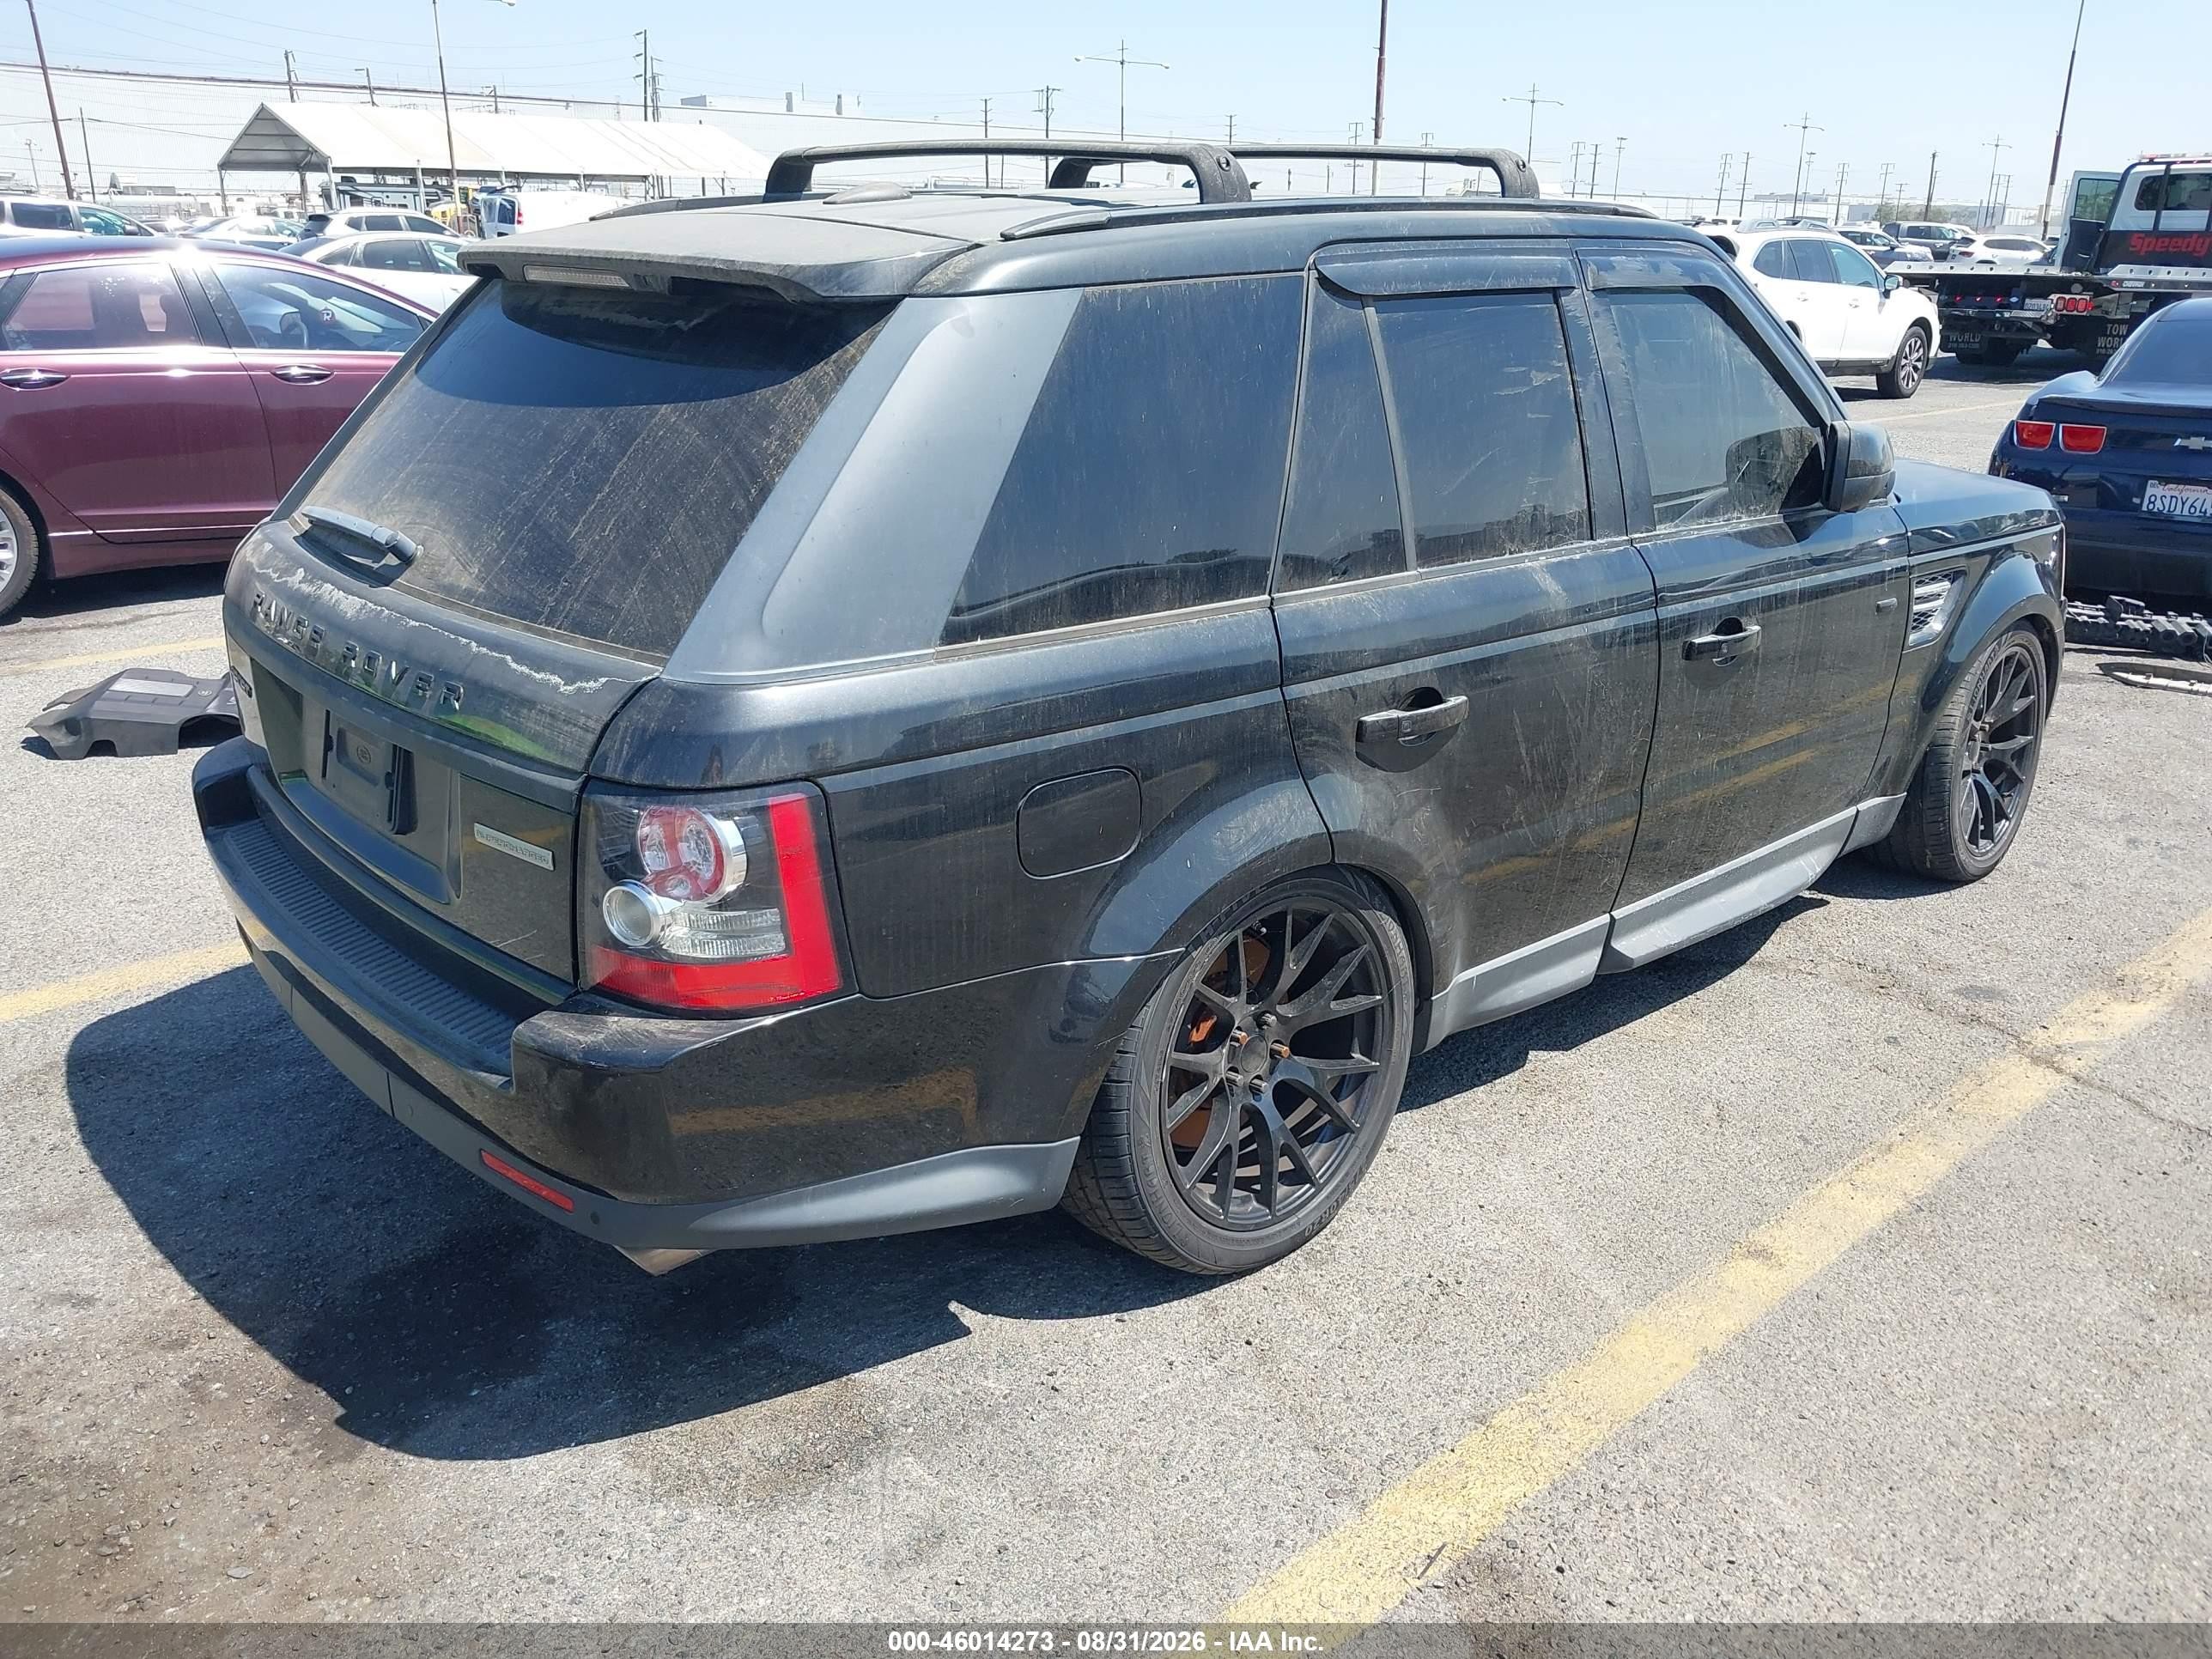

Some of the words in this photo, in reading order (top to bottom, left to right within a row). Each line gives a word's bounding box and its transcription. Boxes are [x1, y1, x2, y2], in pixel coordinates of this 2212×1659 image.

[2106, 324, 2129, 335] TOW
[2147, 494, 2212, 516] 8SDY64
[253, 592, 326, 644] RANGE
[343, 641, 465, 711] ROVER
